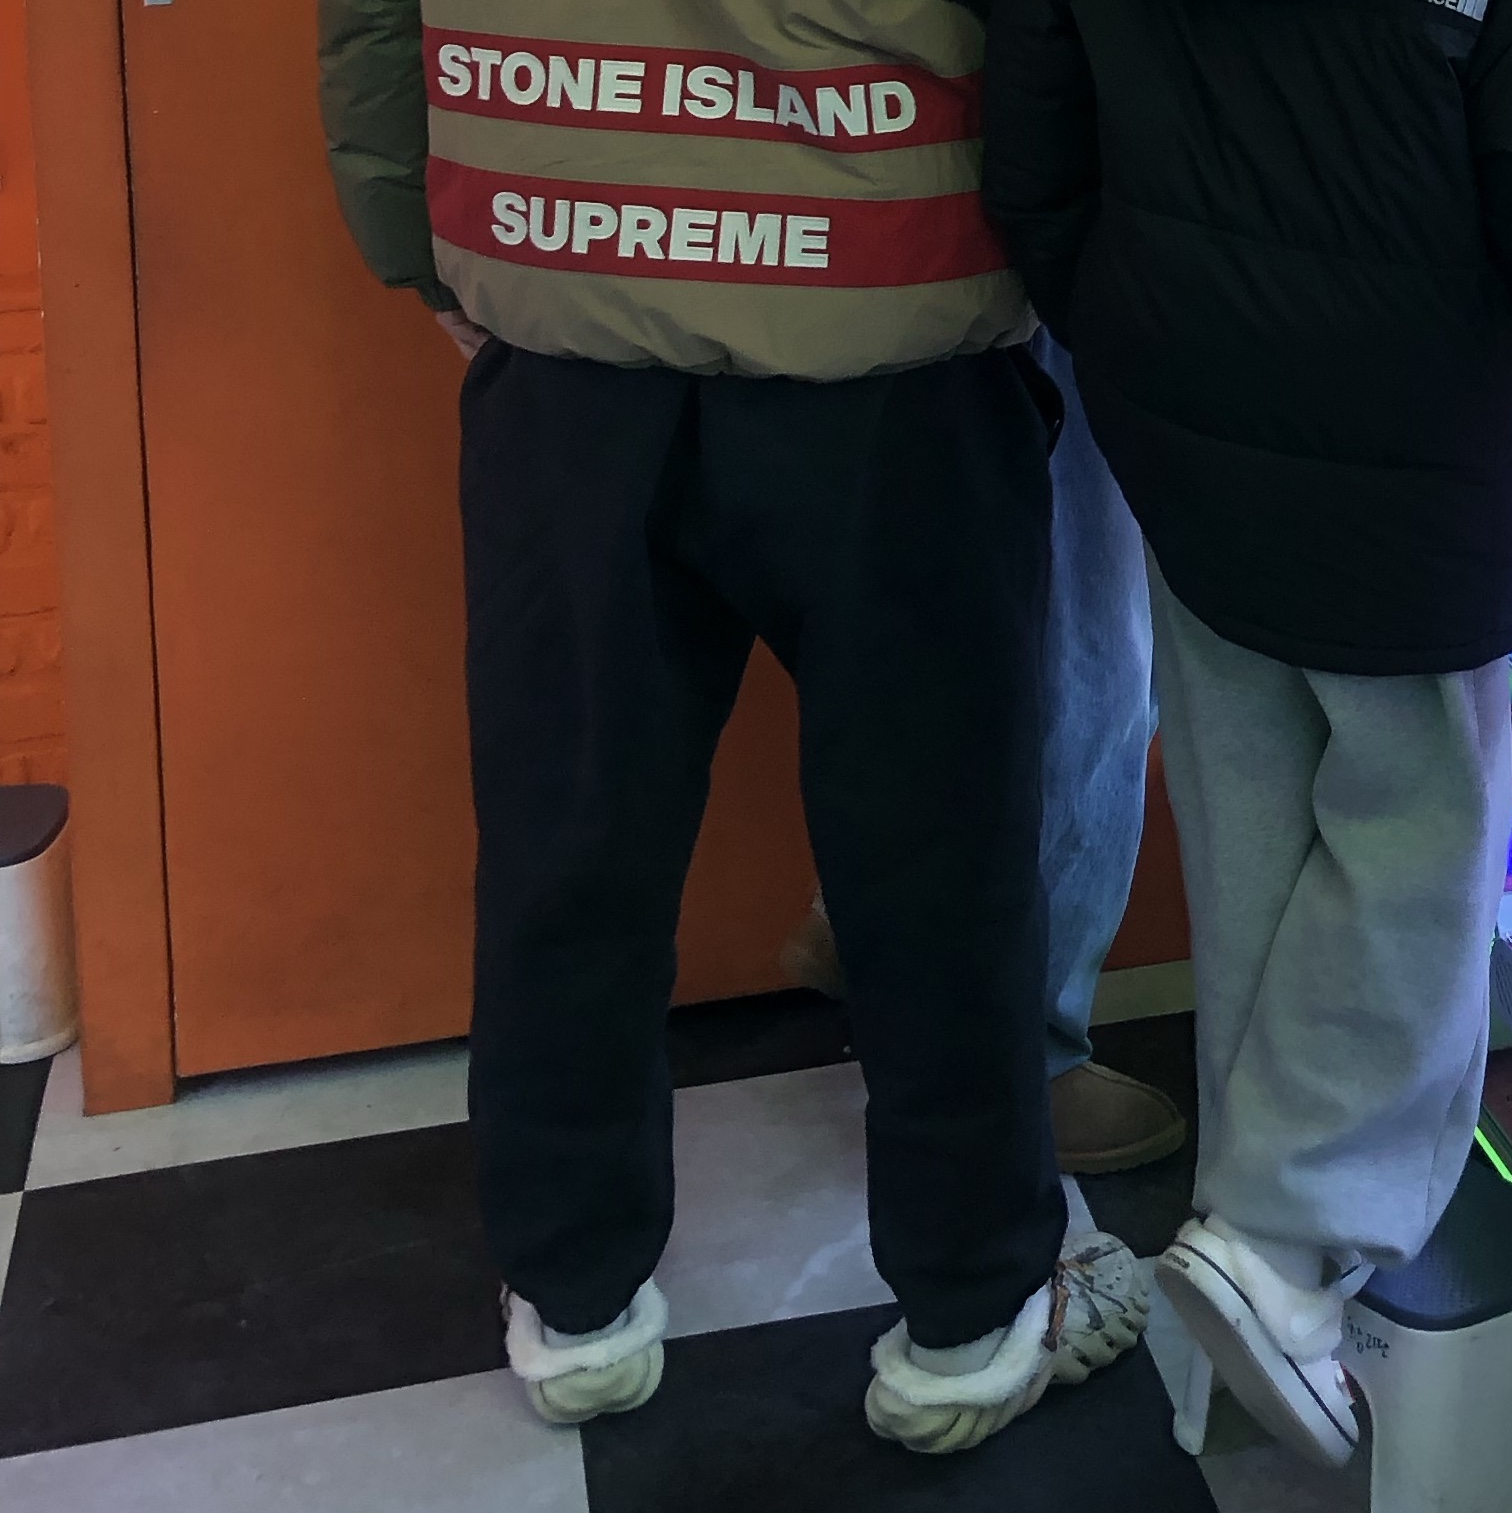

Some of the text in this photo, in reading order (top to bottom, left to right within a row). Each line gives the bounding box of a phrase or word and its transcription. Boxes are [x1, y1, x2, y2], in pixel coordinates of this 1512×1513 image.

[438, 44, 916, 138] STONE ISLAND
[491, 191, 830, 269] SUPREME
